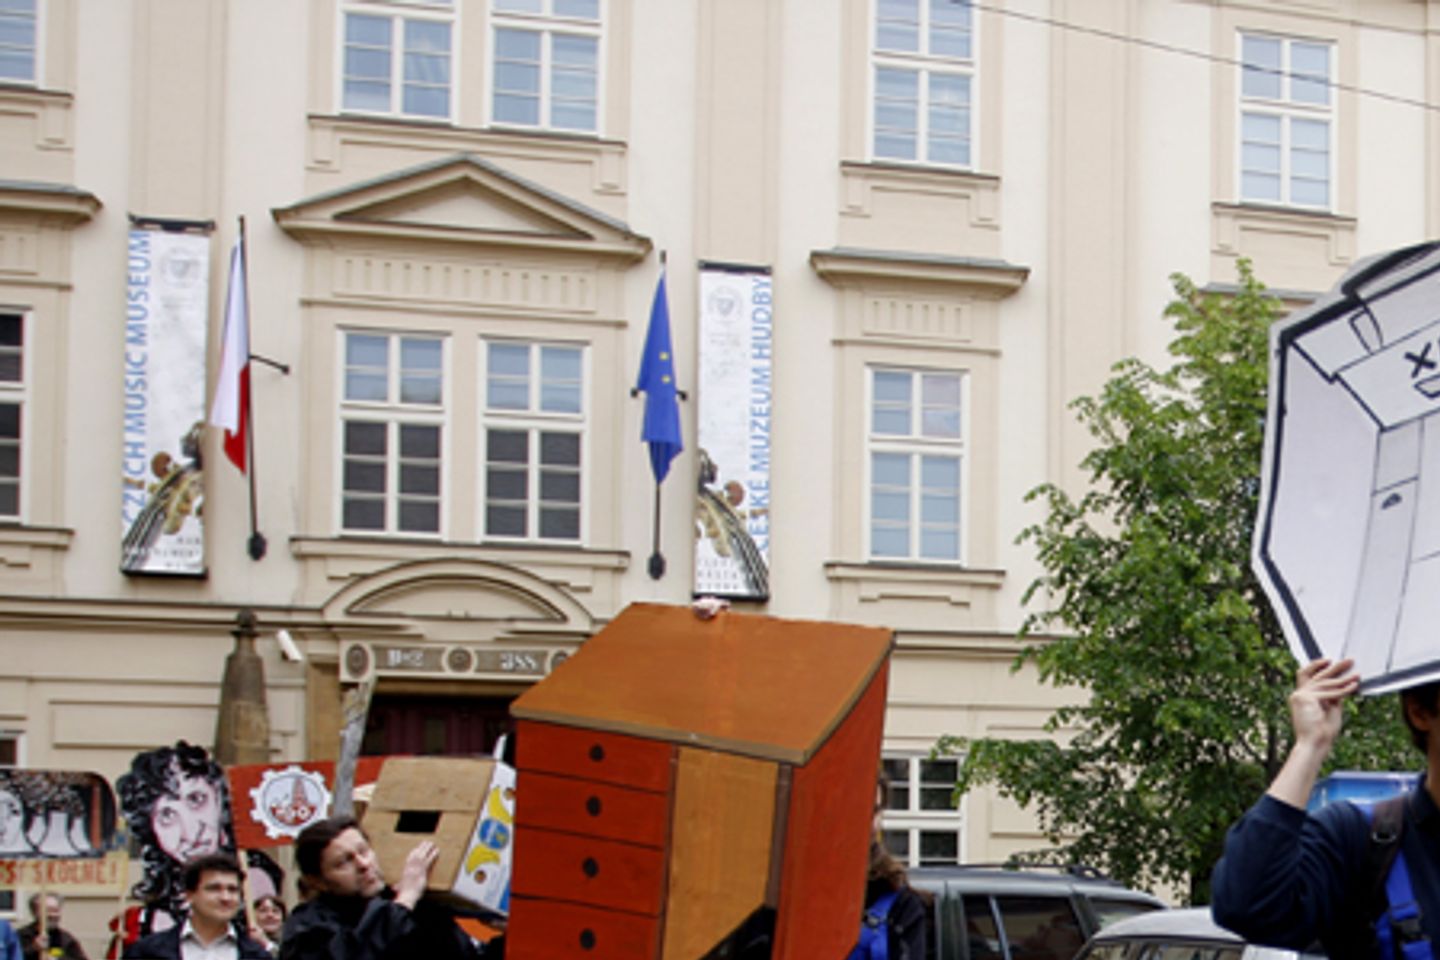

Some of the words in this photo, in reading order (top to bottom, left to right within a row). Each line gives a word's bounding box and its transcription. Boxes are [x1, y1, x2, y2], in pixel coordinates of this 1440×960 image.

[127, 231, 151, 346] MUSEUM
[752, 277, 773, 360] HUDBY
[124, 351, 149, 436] MUSIC
[750, 367, 772, 472] MUZEUM
